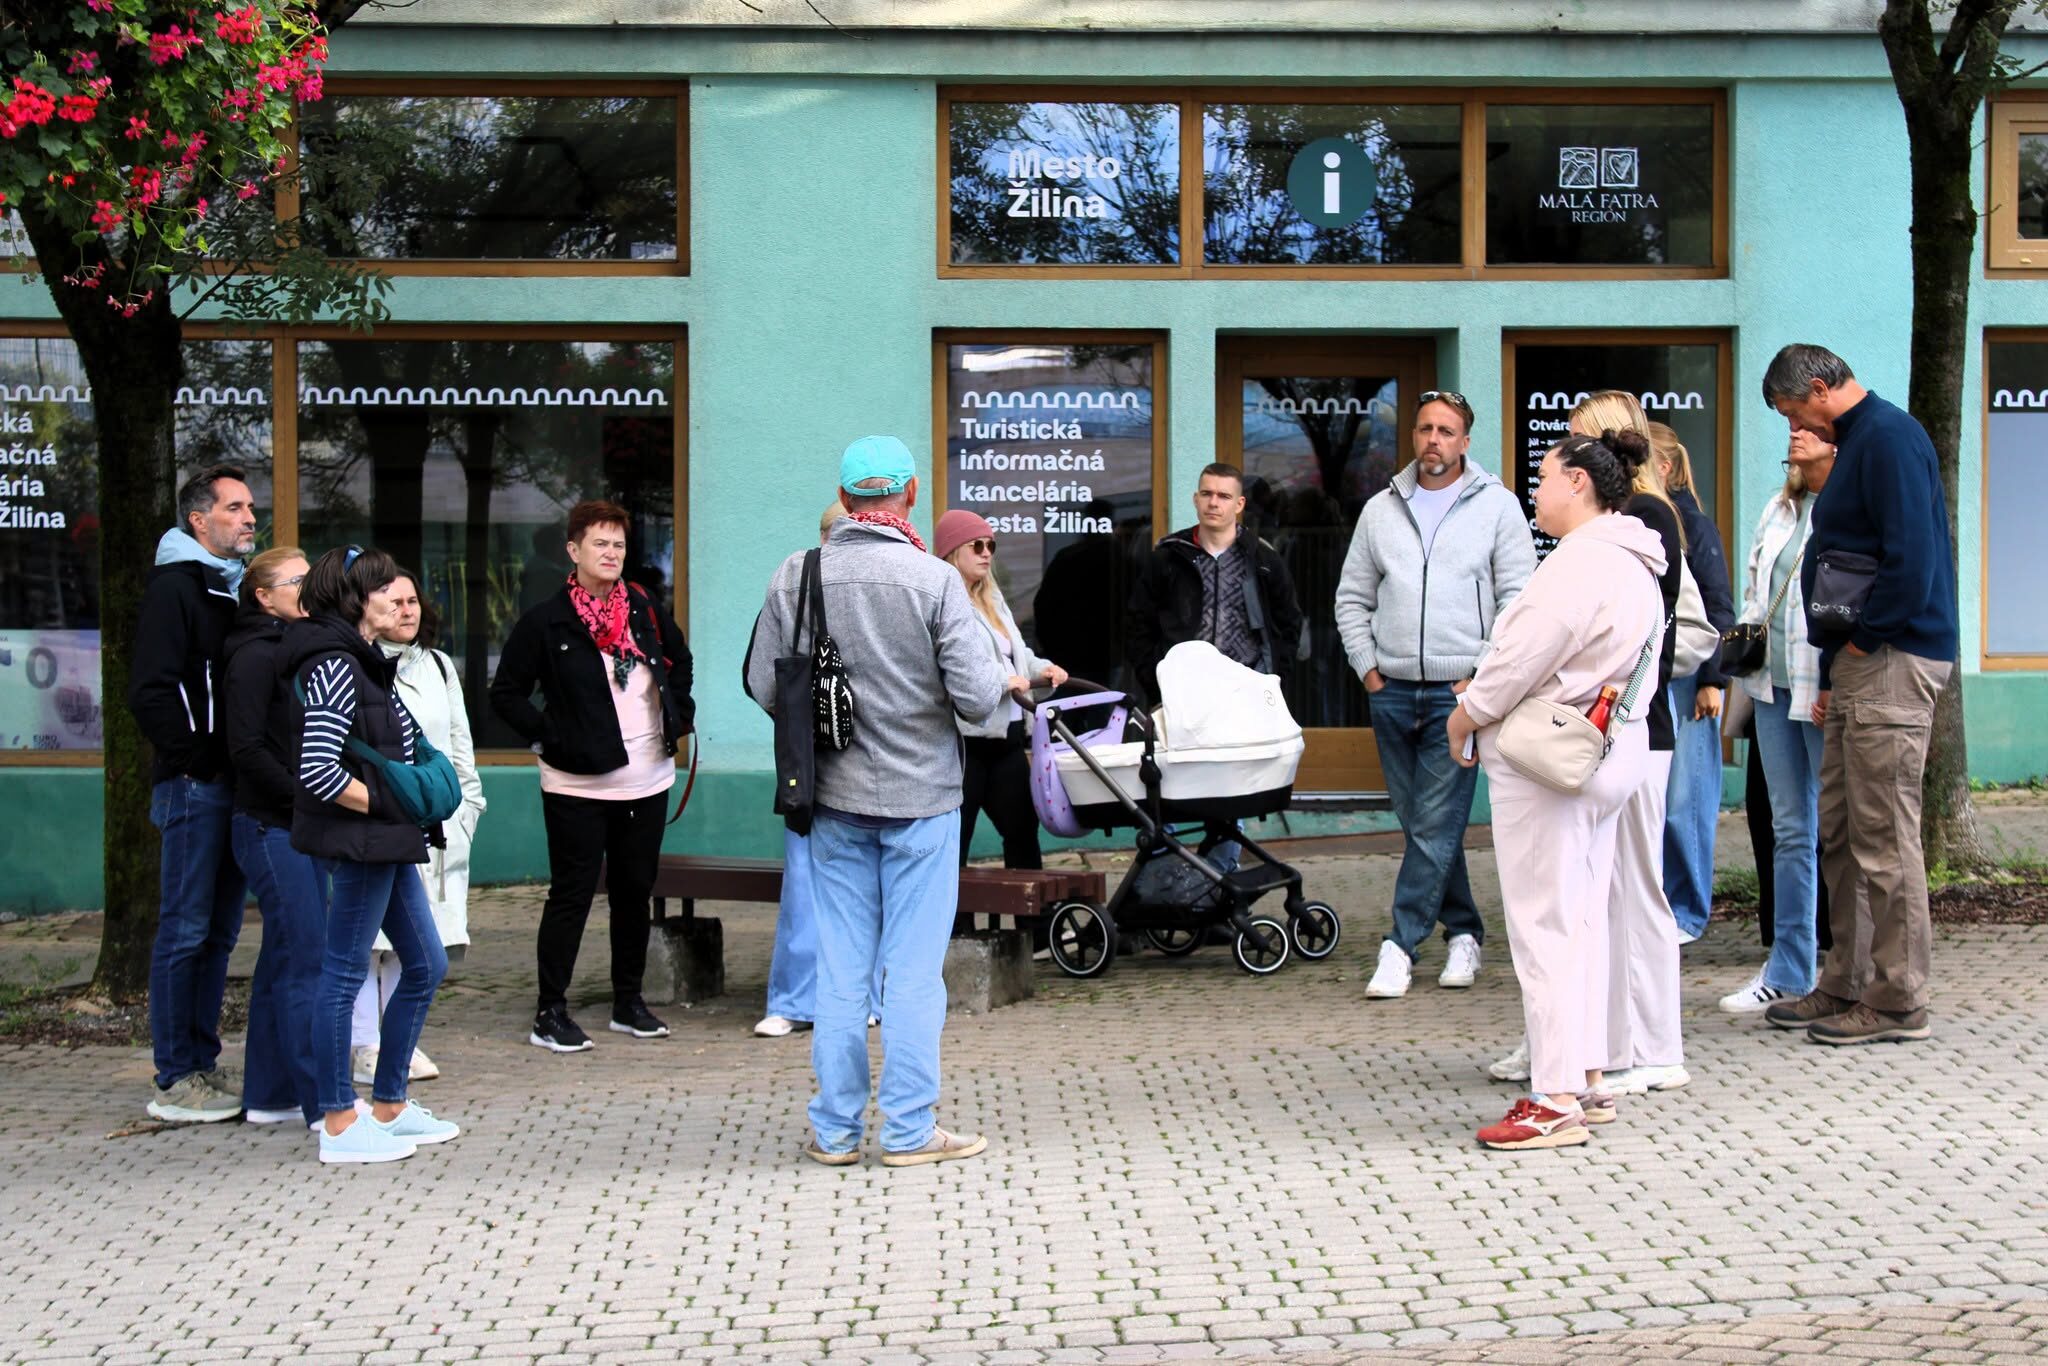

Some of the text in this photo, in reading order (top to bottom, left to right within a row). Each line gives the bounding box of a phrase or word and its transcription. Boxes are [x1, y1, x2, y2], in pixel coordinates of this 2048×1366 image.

[1008, 149, 1121, 180] Mesto
[1007, 180, 1107, 218] Žilina
[1600, 193, 1659, 208] FATRA
[0, 411, 34, 433] ká
[959, 418, 1083, 440] Turistická
[959, 448, 1105, 471] informačná
[959, 480, 1093, 502] kancelária
[0, 501, 66, 528] Žilina
[984, 506, 1113, 534] esta Žilina
